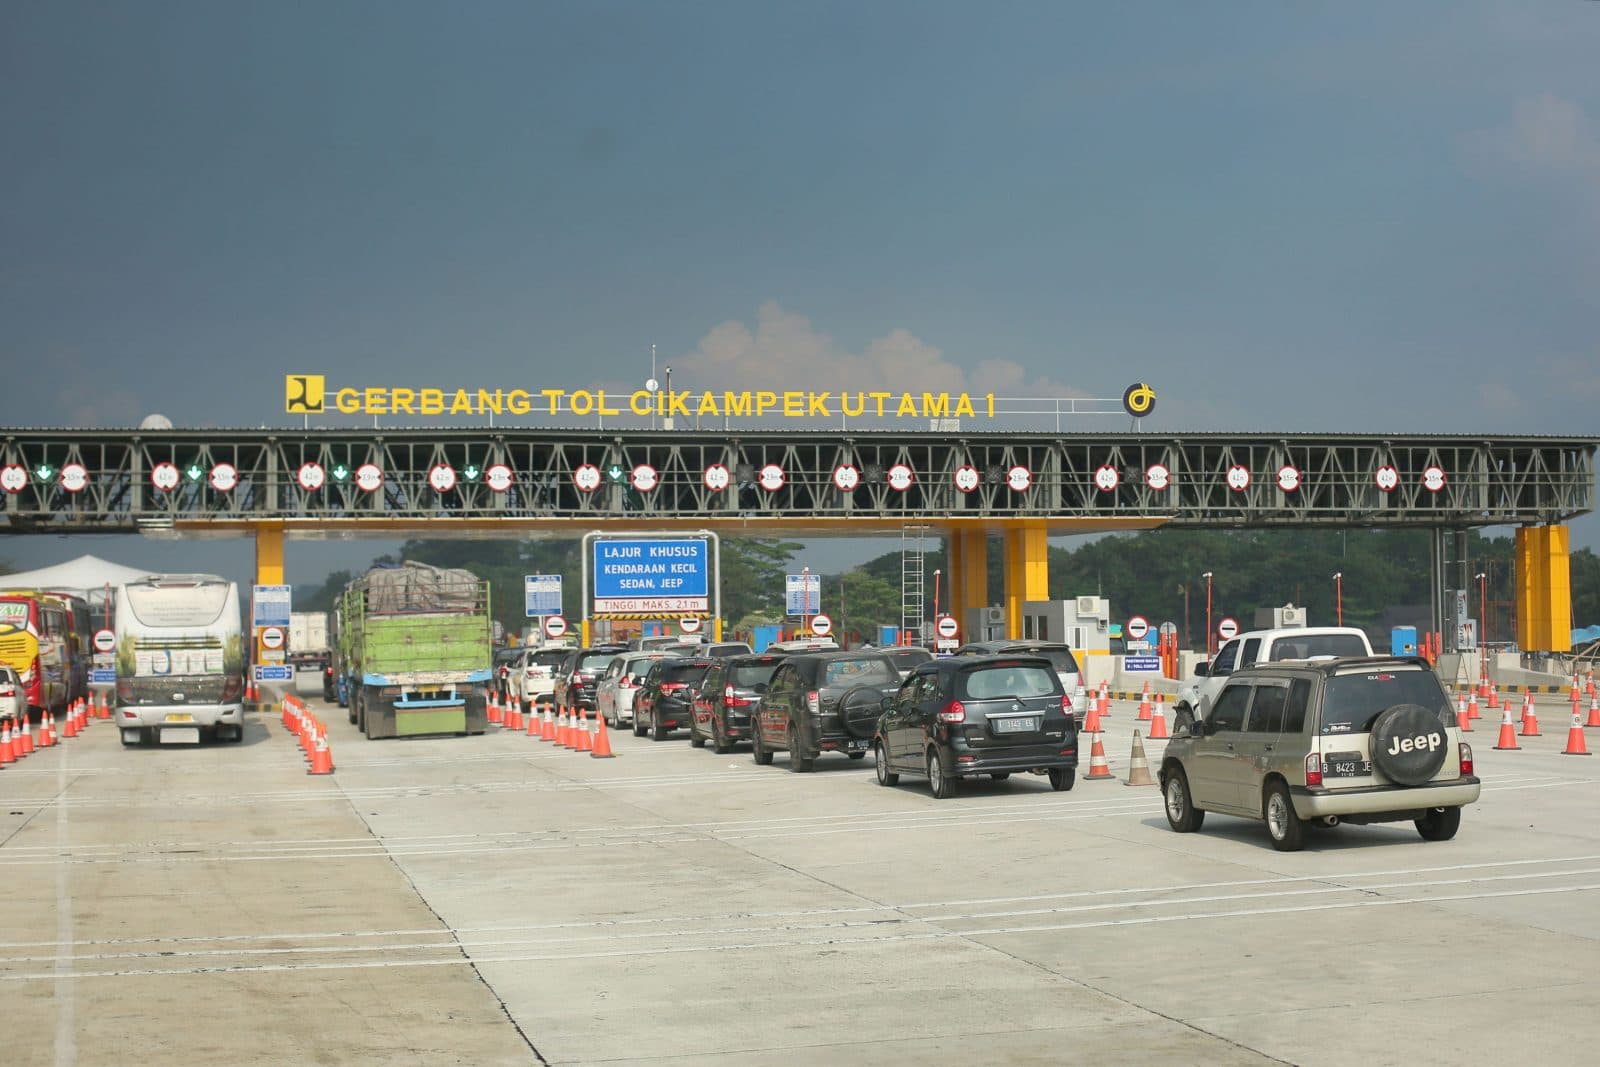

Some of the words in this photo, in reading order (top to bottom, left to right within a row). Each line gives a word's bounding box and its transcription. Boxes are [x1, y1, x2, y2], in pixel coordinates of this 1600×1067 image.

[336, 388, 530, 415] GERBANG
[542, 390, 619, 416] TOL
[630, 390, 831, 417] CIKAMPEK
[842, 392, 976, 418] UTAMA
[986, 393, 994, 418] 1
[604, 547, 641, 558] LAJUR
[650, 546, 698, 557] KHUSUS
[604, 564, 665, 574] KENDARAAN
[671, 564, 697, 573] KECIL
[620, 579, 655, 589] SEDAN,
[660, 579, 683, 588] JEEP
[604, 601, 637, 610] TINGGI
[1388, 732, 1440, 755] Jeep
[1323, 764, 1328, 773] B
[1336, 763, 1354, 772] 8423
